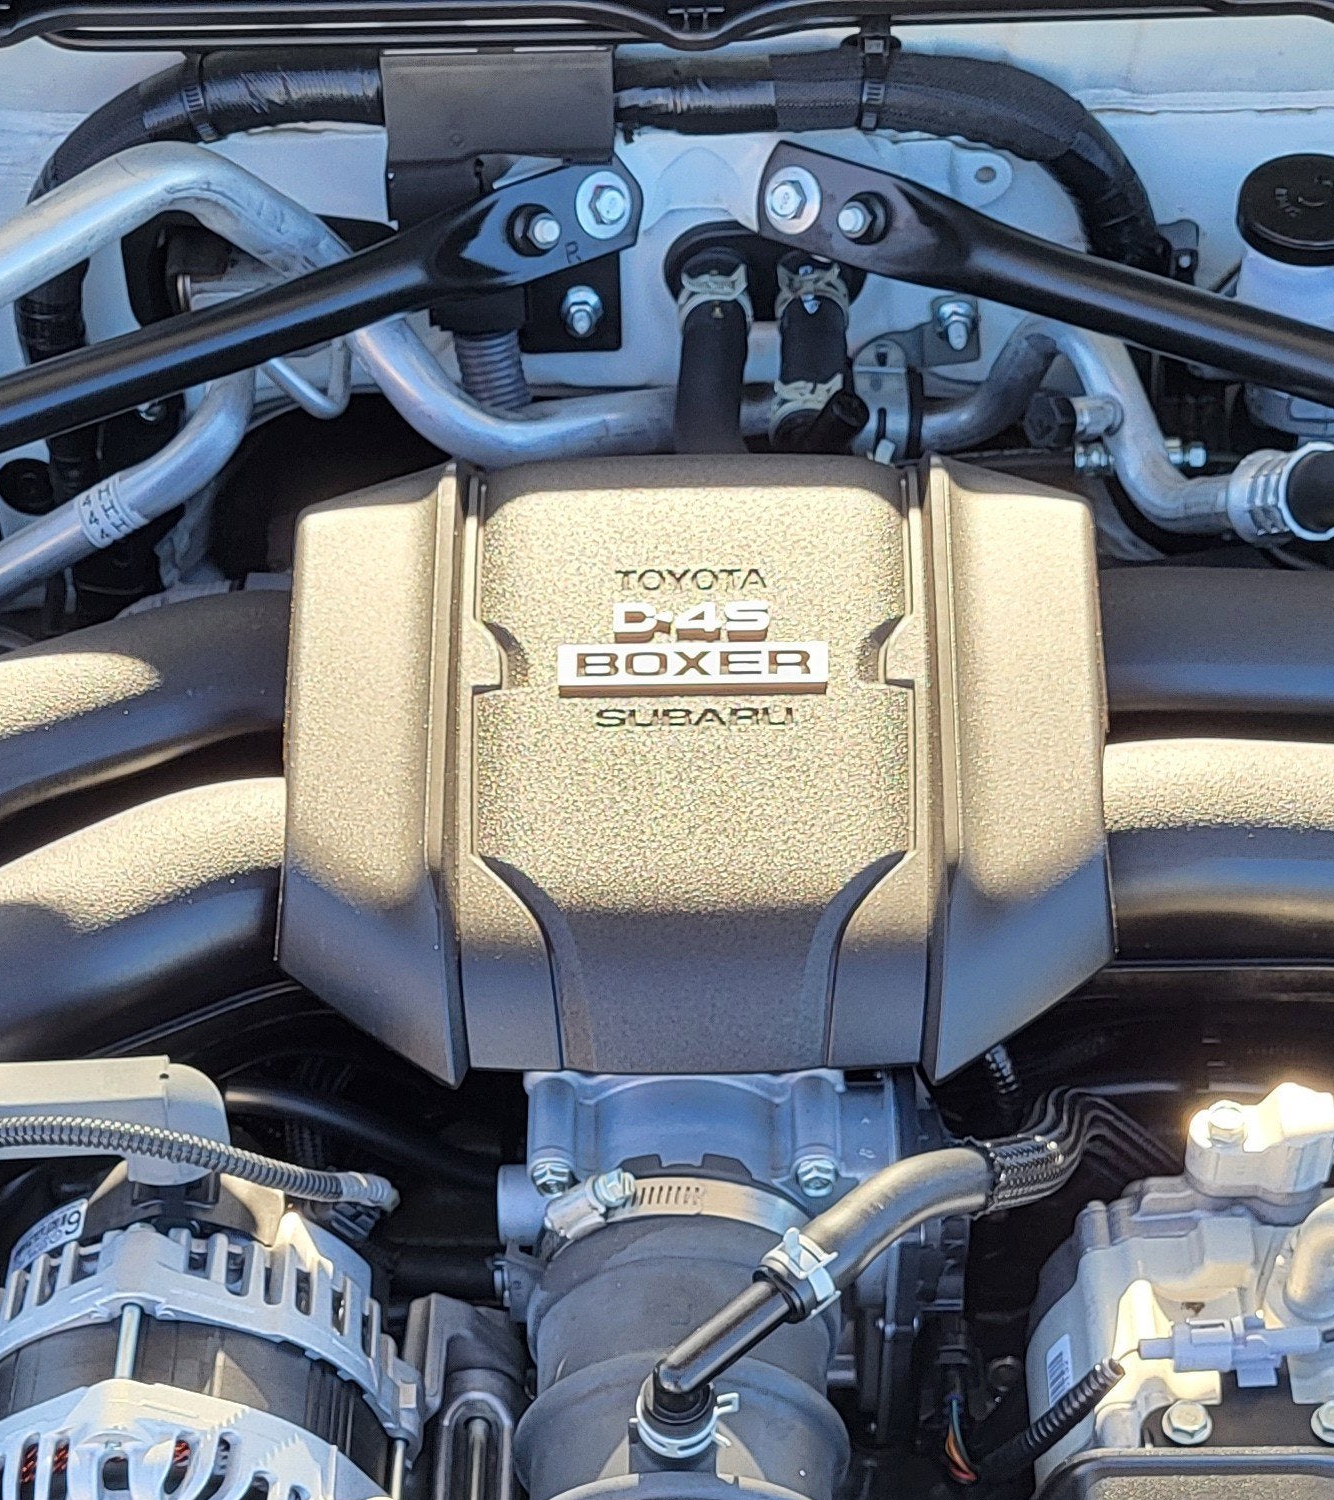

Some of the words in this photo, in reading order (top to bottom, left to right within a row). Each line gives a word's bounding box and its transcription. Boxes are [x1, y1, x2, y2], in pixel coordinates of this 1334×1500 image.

[617, 568, 767, 592] TOYOTA
[576, 650, 812, 678] BOXER
[595, 706, 795, 728] SUBARU
